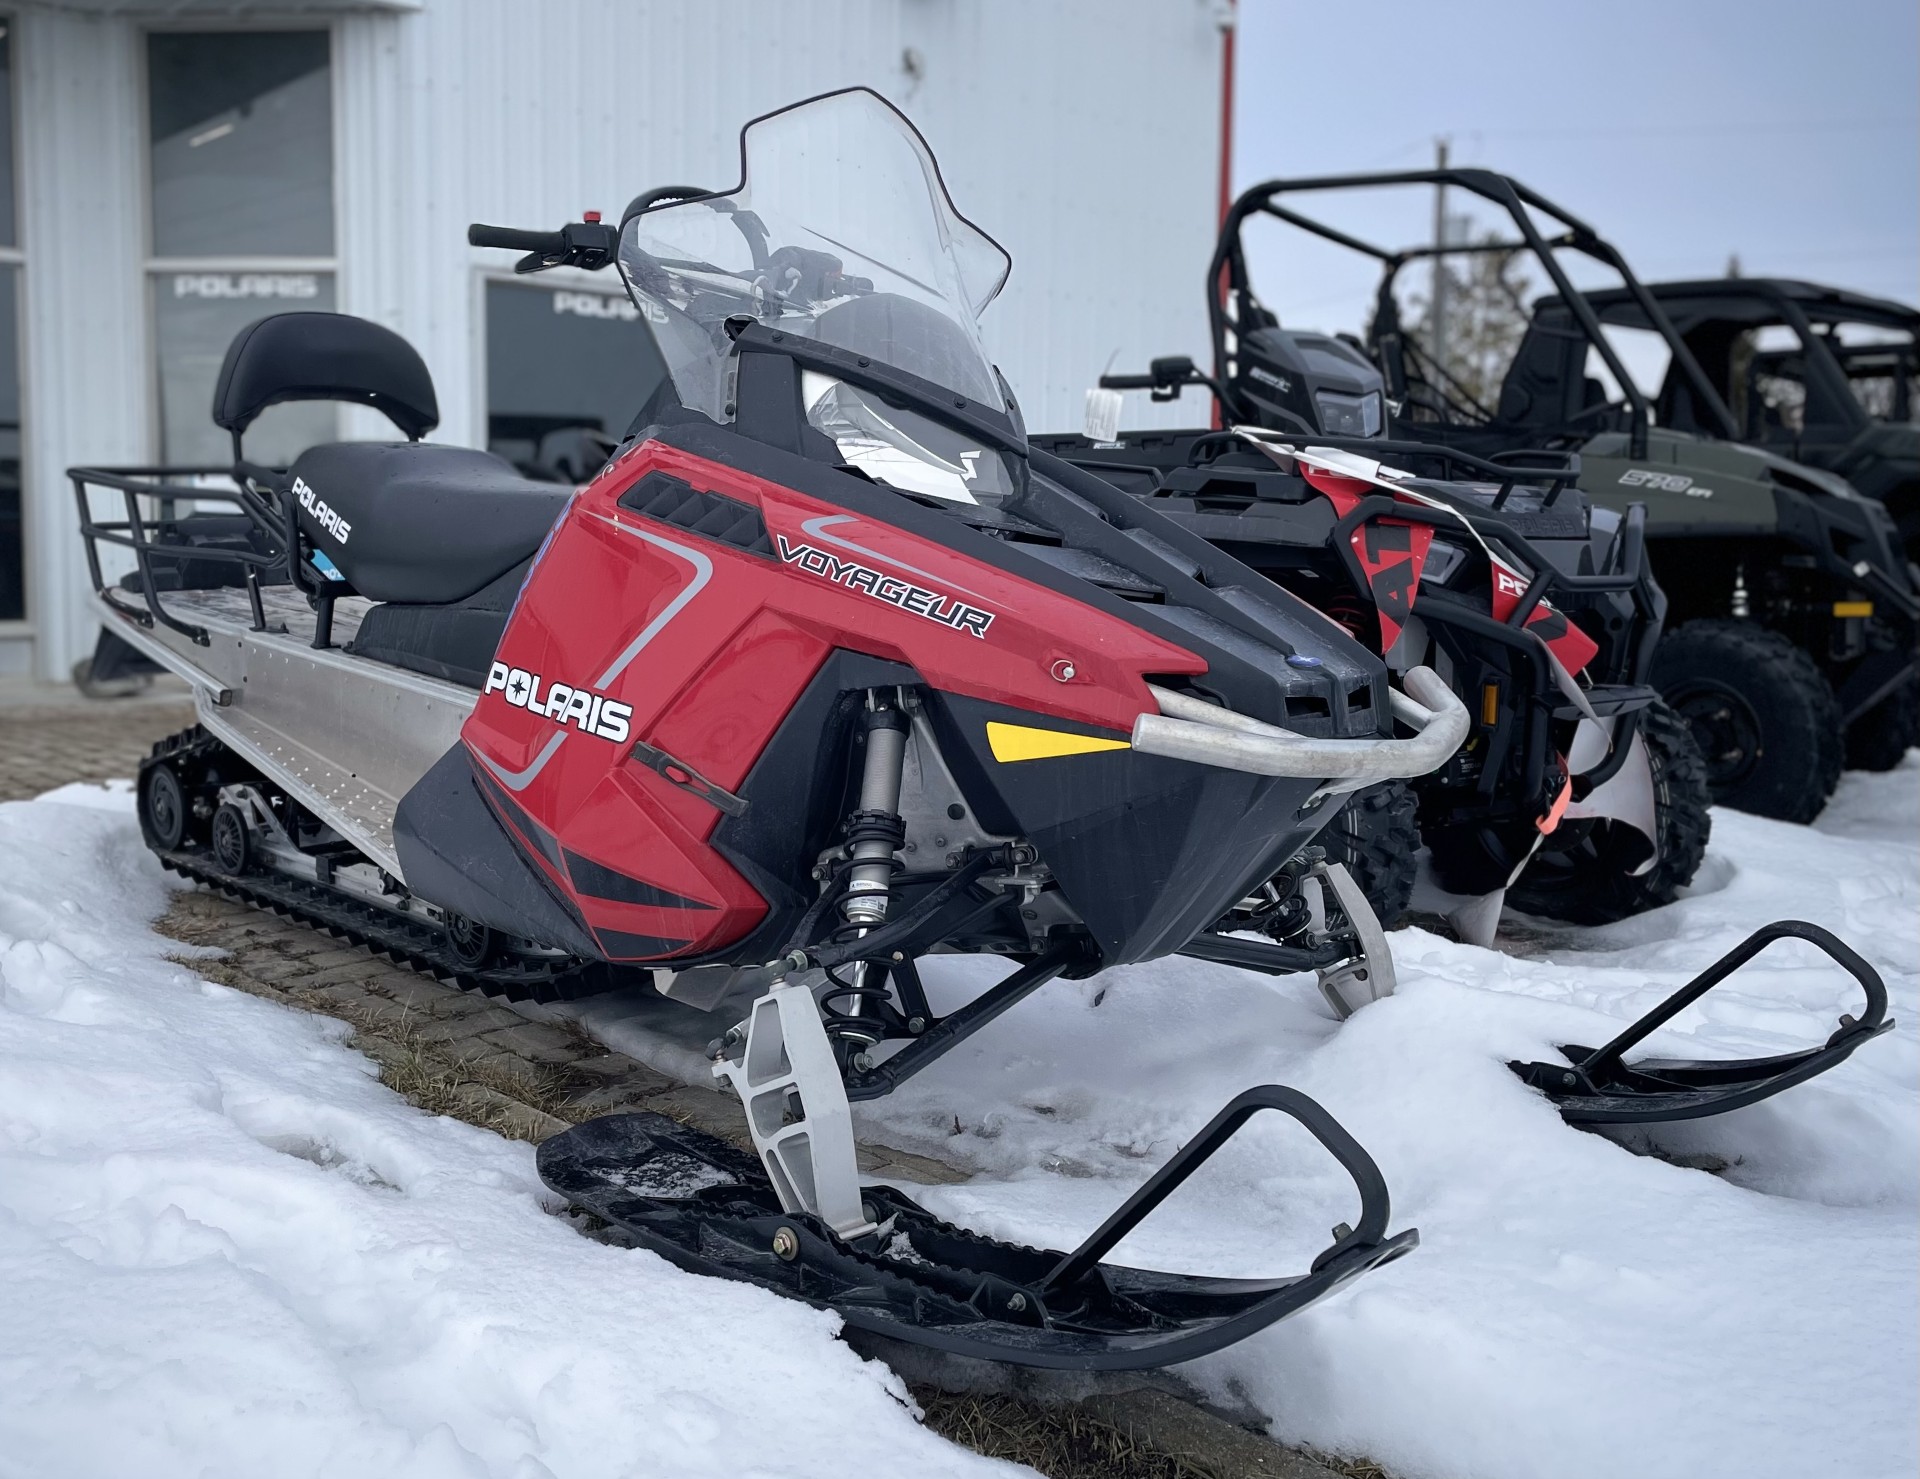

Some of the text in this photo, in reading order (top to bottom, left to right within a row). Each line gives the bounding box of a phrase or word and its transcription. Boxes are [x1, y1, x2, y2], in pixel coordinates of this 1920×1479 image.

[174, 274, 318, 298] POLARIS
[291, 476, 352, 545] POLARIS
[1618, 469, 1694, 493] 570
[777, 534, 996, 639] VOYAGEUR
[483, 660, 633, 744] POLARIS
